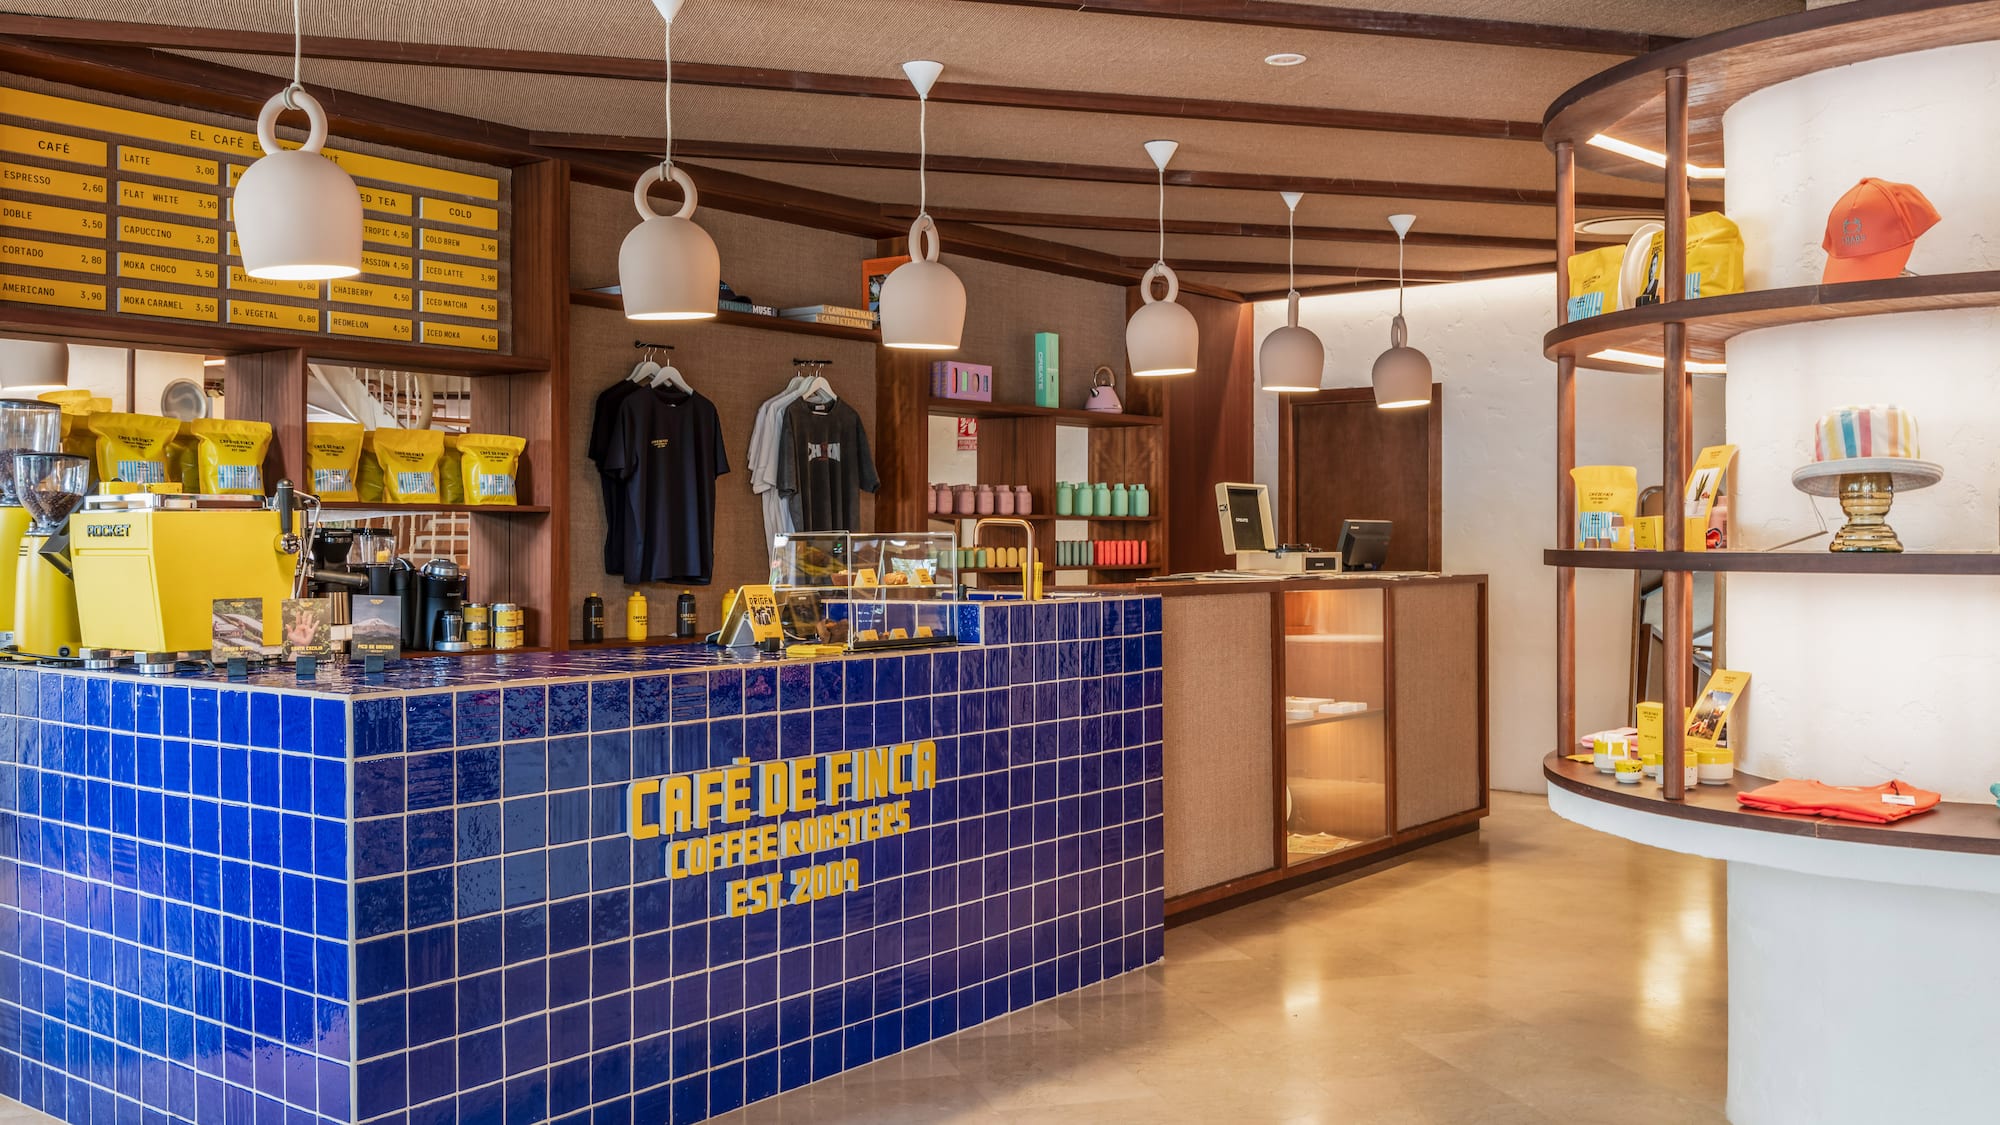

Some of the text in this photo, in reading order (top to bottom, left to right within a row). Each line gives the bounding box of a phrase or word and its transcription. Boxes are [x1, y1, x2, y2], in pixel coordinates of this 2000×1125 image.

[190, 129, 205, 142] EL
[213, 134, 244, 148] CAFÉ
[38, 140, 70, 154] CAFÉ
[124, 153, 151, 166] LATTE
[195, 164, 215, 177] 3,00
[4, 170, 51, 185] ESPRESSO
[82, 182, 104, 193] 2,60
[124, 188, 179, 205] FLAT WHITE
[378, 196, 396, 207] TEA
[198, 198, 217, 211] 3,90
[3, 207, 32, 220] DOBLE
[449, 207, 472, 219] COLD
[82, 218, 103, 229] 3,50
[124, 224, 172, 239] CAPUCCINO
[364, 225, 390, 237] TROPIC
[196, 234, 215, 246] 3,20
[425, 235, 460, 247] COLD BREW
[2, 245, 44, 258] CORTADO
[81, 254, 102, 265] 2,80
[361, 256, 390, 269] PASSION
[124, 259, 177, 274] MOKA CHOCO
[426, 266, 464, 279] ICED LATTE
[195, 268, 215, 280] 3,50
[2, 282, 55, 297] AMERICANO
[80, 290, 102, 301] 3,90
[333, 285, 374, 297] CHAIBERRY
[124, 295, 184, 311] MOKA CARAMEL
[195, 303, 215, 314] 3,50
[426, 297, 468, 310] ICED MATCHA
[233, 307, 279, 320] B. VEGETAL
[752, 304, 772, 316] MUSE
[333, 318, 369, 329] REDMELON
[426, 328, 461, 339] ICED MOKA
[87, 524, 131, 537] ROCKET
[627, 740, 937, 840] CAFÉ DE FINCA
[665, 799, 911, 880] COFFEE ROASTERS
[726, 857, 859, 918] EST. 2009
